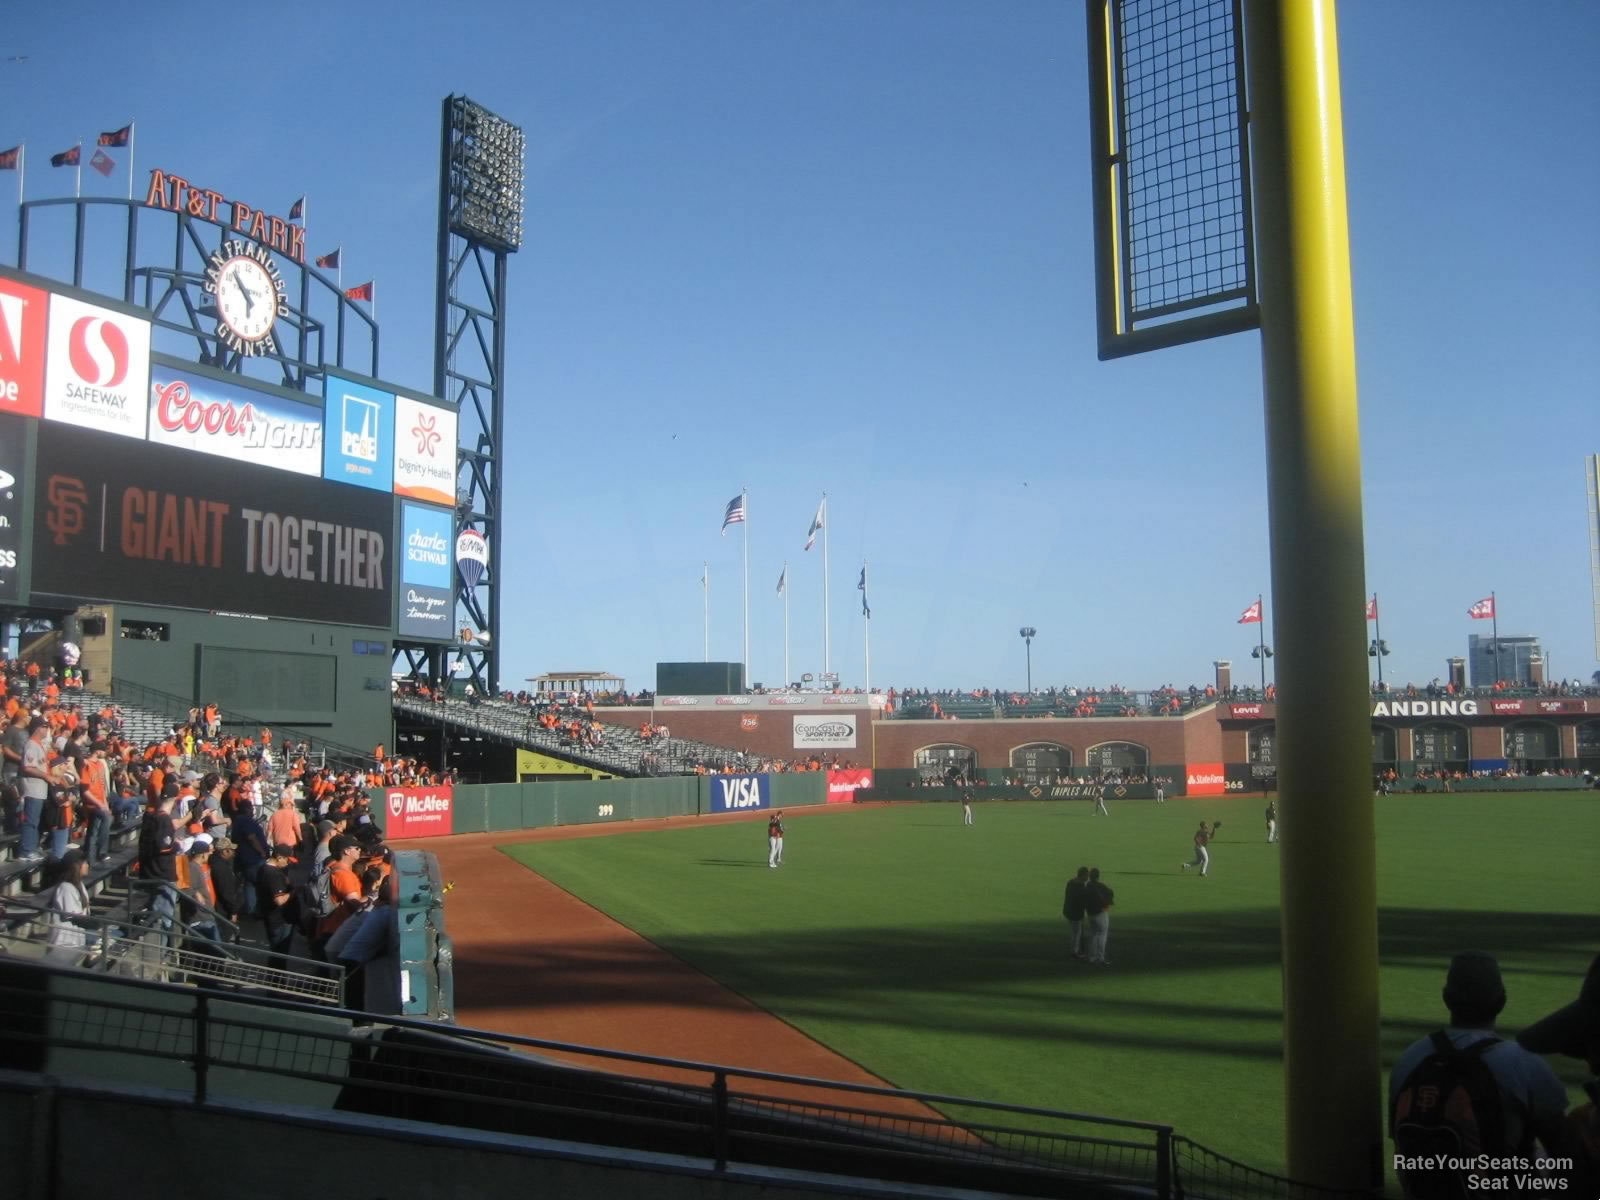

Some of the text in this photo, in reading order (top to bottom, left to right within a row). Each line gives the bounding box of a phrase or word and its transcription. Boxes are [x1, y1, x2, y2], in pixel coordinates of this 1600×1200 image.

[144, 168, 306, 263] AT&T PARK
[205, 239, 289, 317] SAN FRANCISCO
[217, 323, 279, 357] GIANTS
[66, 383, 128, 409] SAFEWAY
[155, 380, 323, 449] Coors LIGHT
[342, 431, 377, 461] PG&E
[399, 458, 452, 481] Dignity Health
[46, 473, 89, 545] SF
[120, 486, 385, 590] GIANT TOGETHER
[408, 528, 447, 551] charles
[408, 548, 448, 565] SCHWAB
[407, 589, 446, 611] Own your
[1370, 700, 1478, 717] ANDING
[720, 777, 760, 808] VISA
[1051, 786, 1080, 796] TRIPLES
[1224, 781, 1244, 789] 365
[406, 794, 449, 813] McAfee
[598, 804, 614, 816] 399
